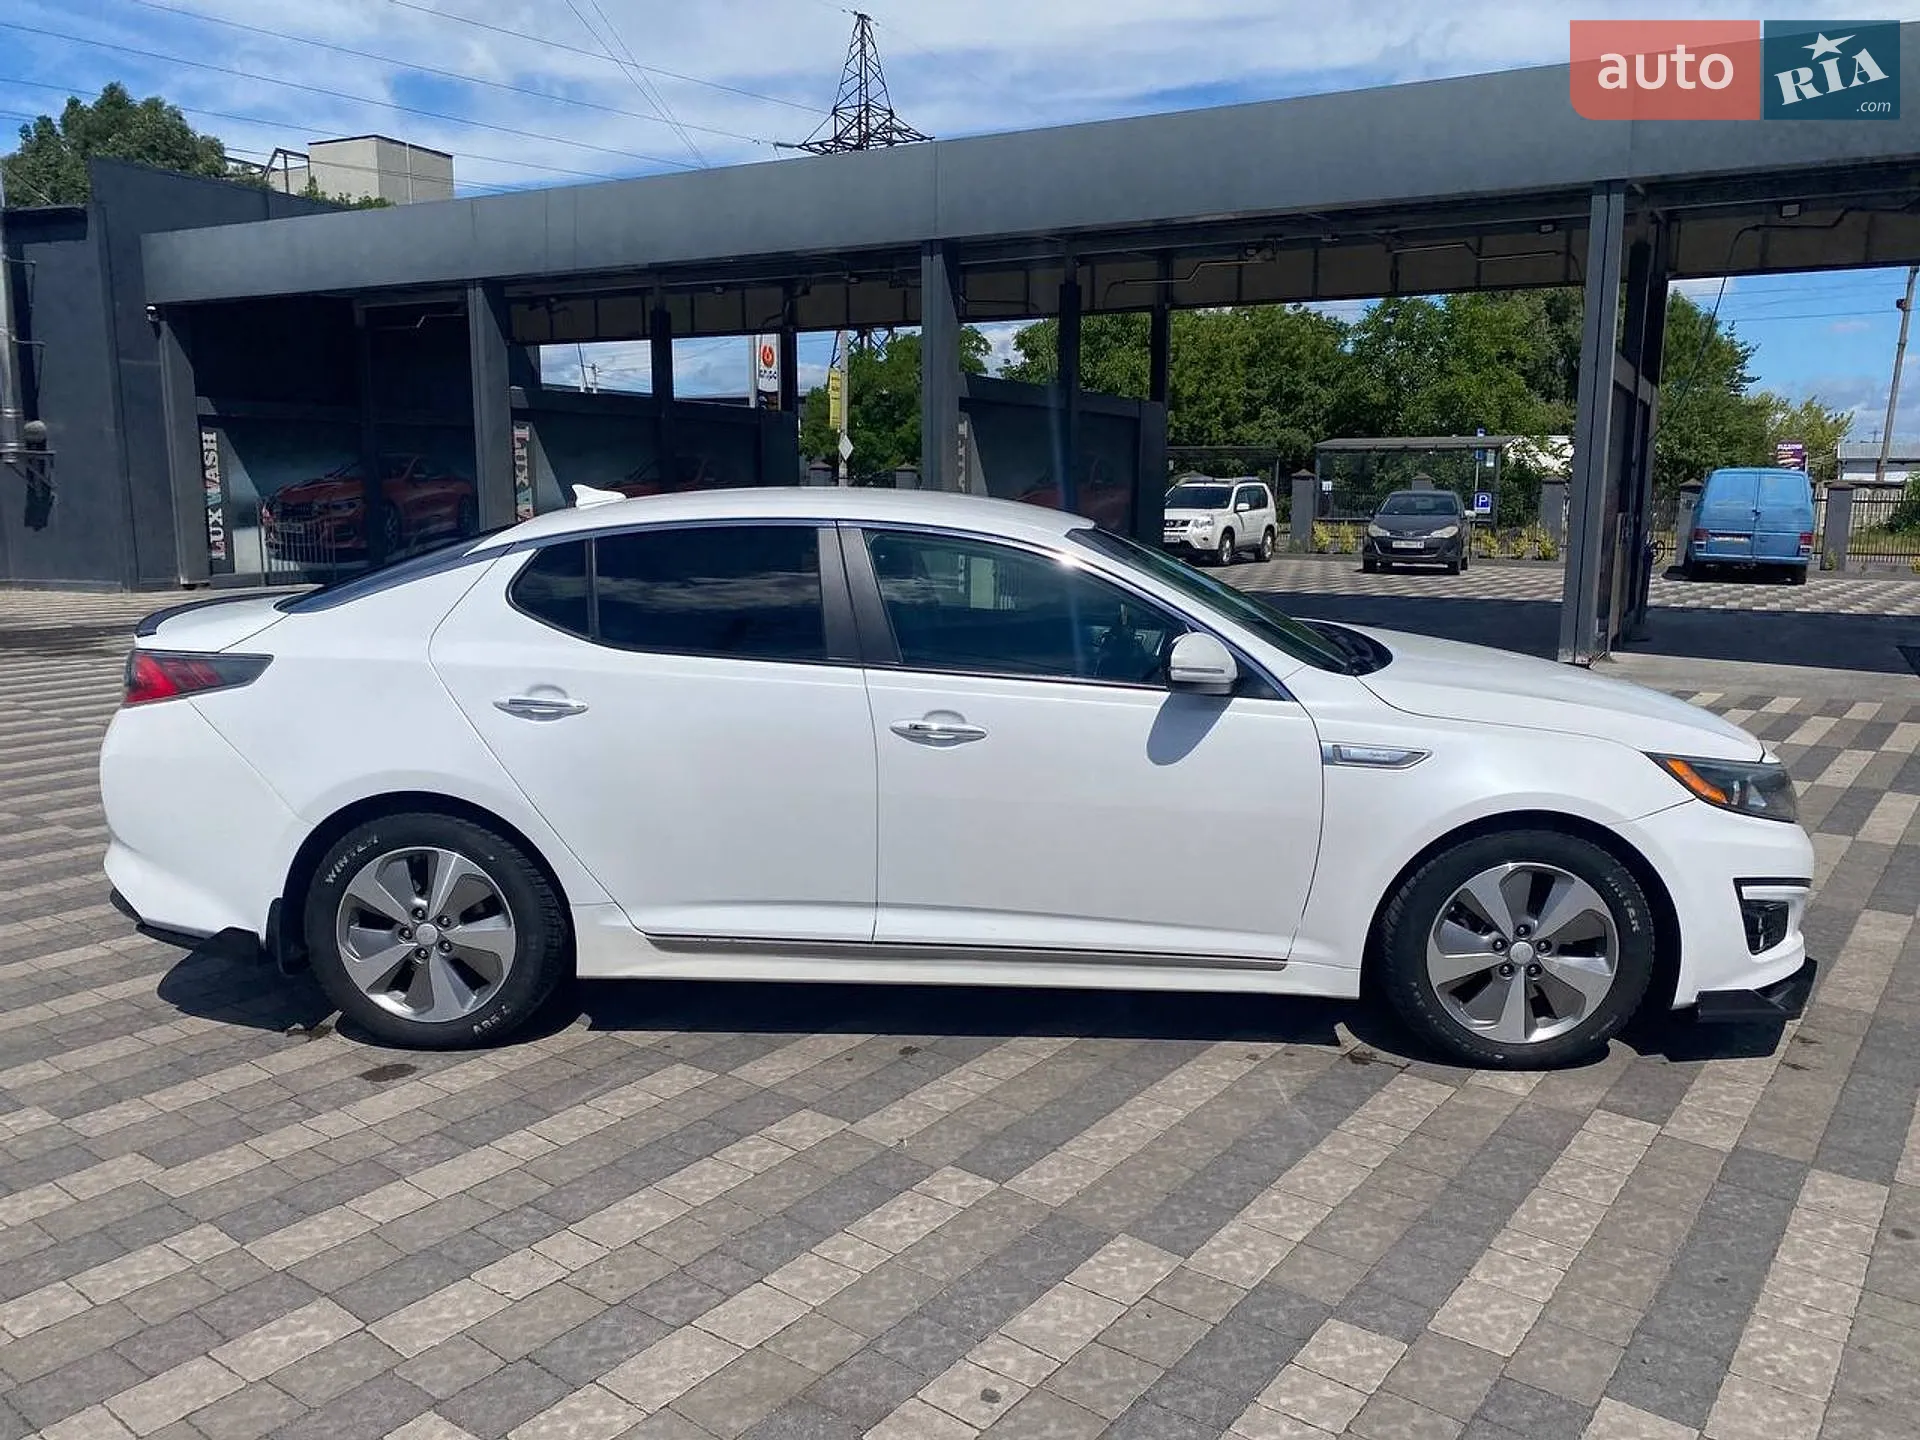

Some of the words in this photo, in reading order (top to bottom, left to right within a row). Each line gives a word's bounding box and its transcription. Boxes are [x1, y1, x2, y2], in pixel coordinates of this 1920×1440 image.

[202, 431, 222, 505] WASH
[1479, 494, 1488, 507] P
[208, 507, 226, 560] LUX
